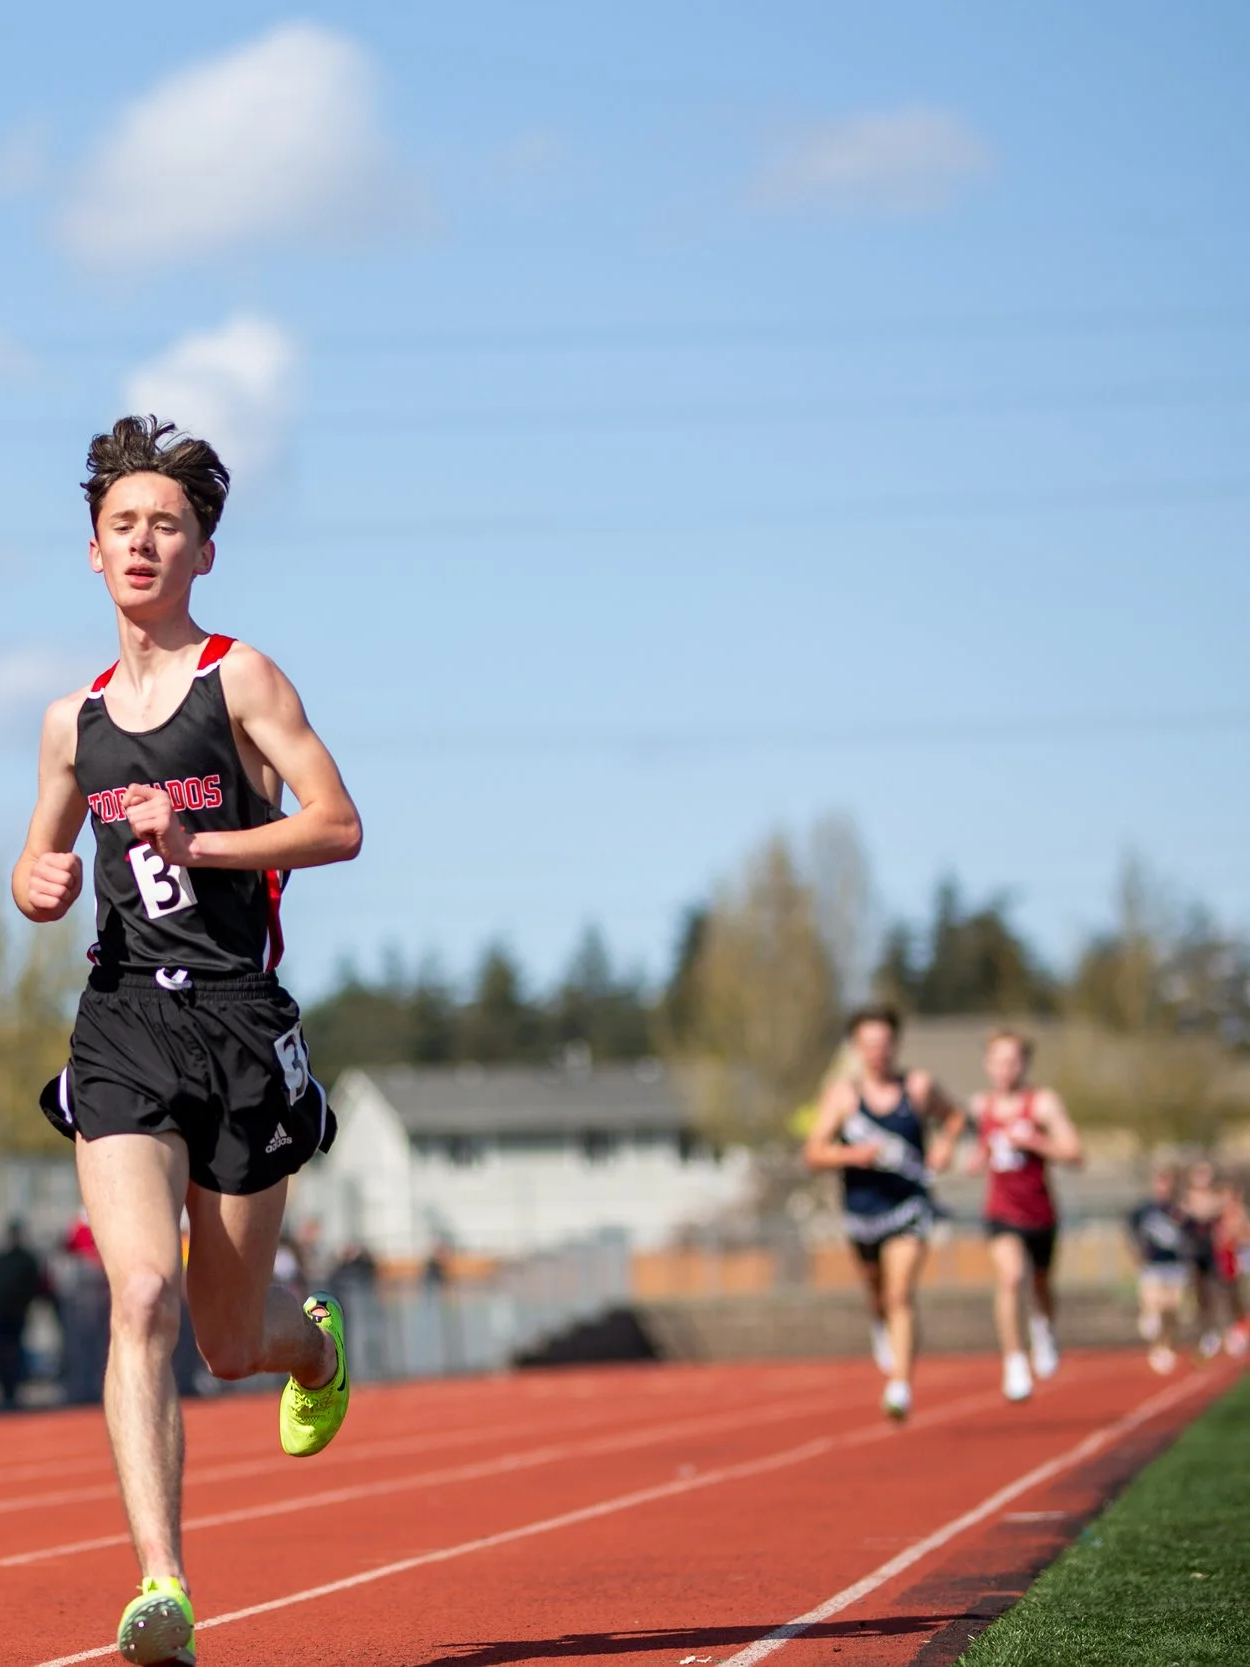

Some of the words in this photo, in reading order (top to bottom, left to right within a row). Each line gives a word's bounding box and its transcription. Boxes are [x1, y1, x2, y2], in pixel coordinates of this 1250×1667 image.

[87, 774, 222, 824] TORDOS
[142, 848, 181, 911] 3
[283, 1033, 305, 1098] 3
